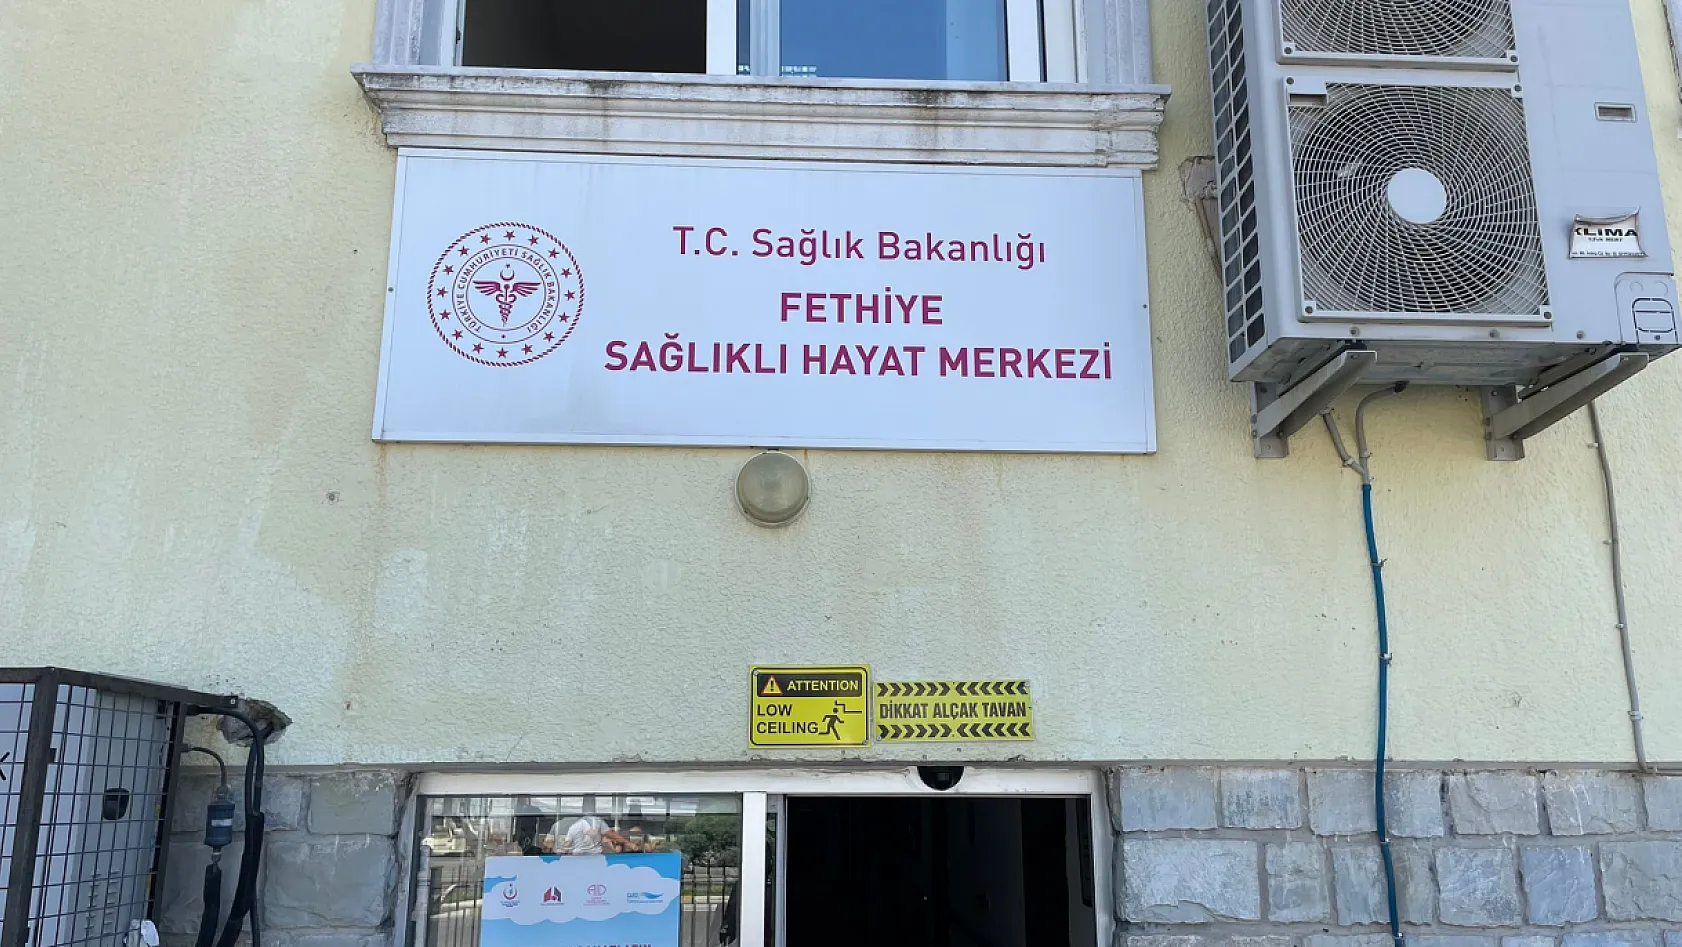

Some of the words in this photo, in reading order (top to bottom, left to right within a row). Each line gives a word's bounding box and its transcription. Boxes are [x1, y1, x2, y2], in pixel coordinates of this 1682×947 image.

[521, 249, 552, 279] SAĞLIK
[673, 226, 738, 256] T.C.
[752, 228, 863, 266] Sağlık
[878, 231, 1045, 271] Bakanlığı
[458, 248, 519, 290] CUMHURİYETİ
[456, 293, 482, 333] TÜRKİYE
[527, 281, 556, 333] BAKANLIĞI
[780, 287, 943, 325] FETHİYE
[605, 333, 787, 374] SAĞLIKLI
[803, 344, 926, 377] HAYAT
[939, 340, 1112, 380] MERKEZİ
[786, 679, 860, 692] ATTENTION
[756, 721, 820, 735] CEILING
[757, 704, 793, 717] LOW
[879, 699, 929, 720] DİKKAT
[932, 702, 979, 720] ALÇAK
[981, 701, 1027, 718] TAVAN
